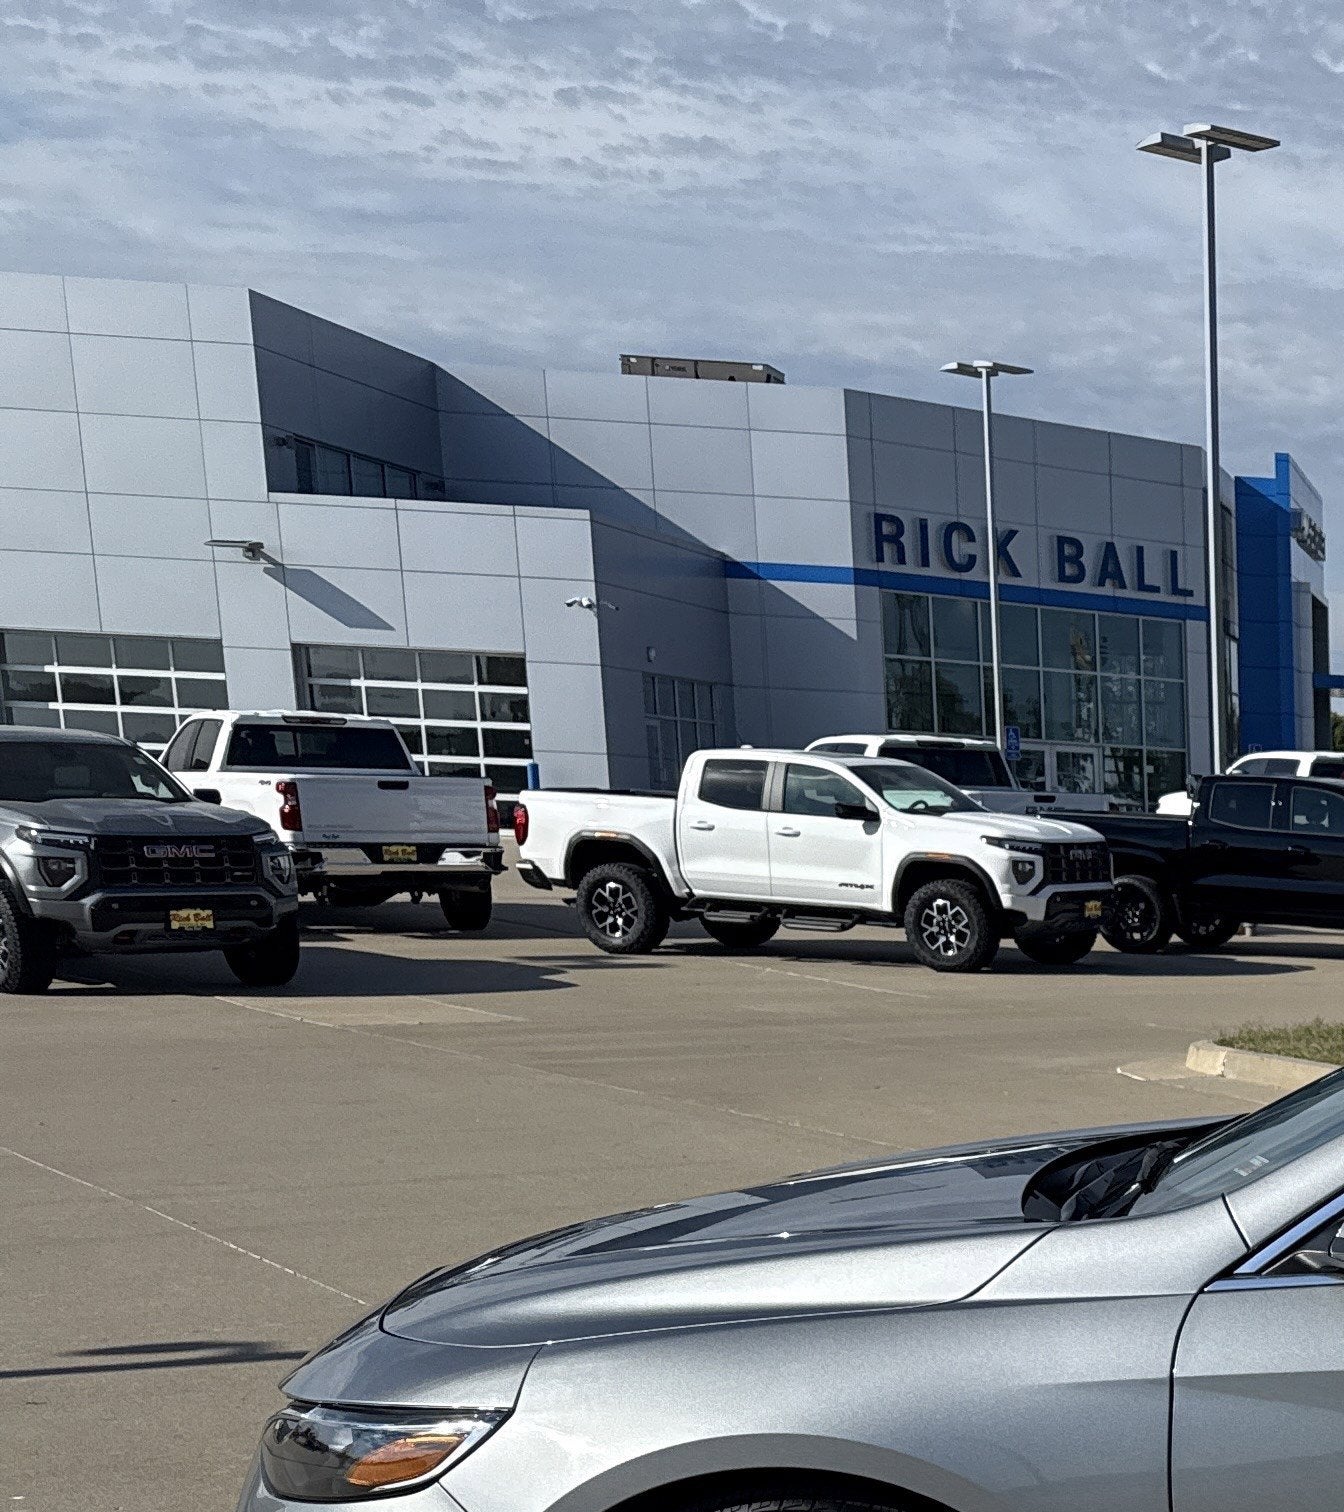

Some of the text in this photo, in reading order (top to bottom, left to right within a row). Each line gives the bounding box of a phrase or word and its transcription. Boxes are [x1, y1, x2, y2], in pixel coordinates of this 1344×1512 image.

[873, 512, 1195, 597] RICK BALL
[144, 845, 215, 858] GMC
